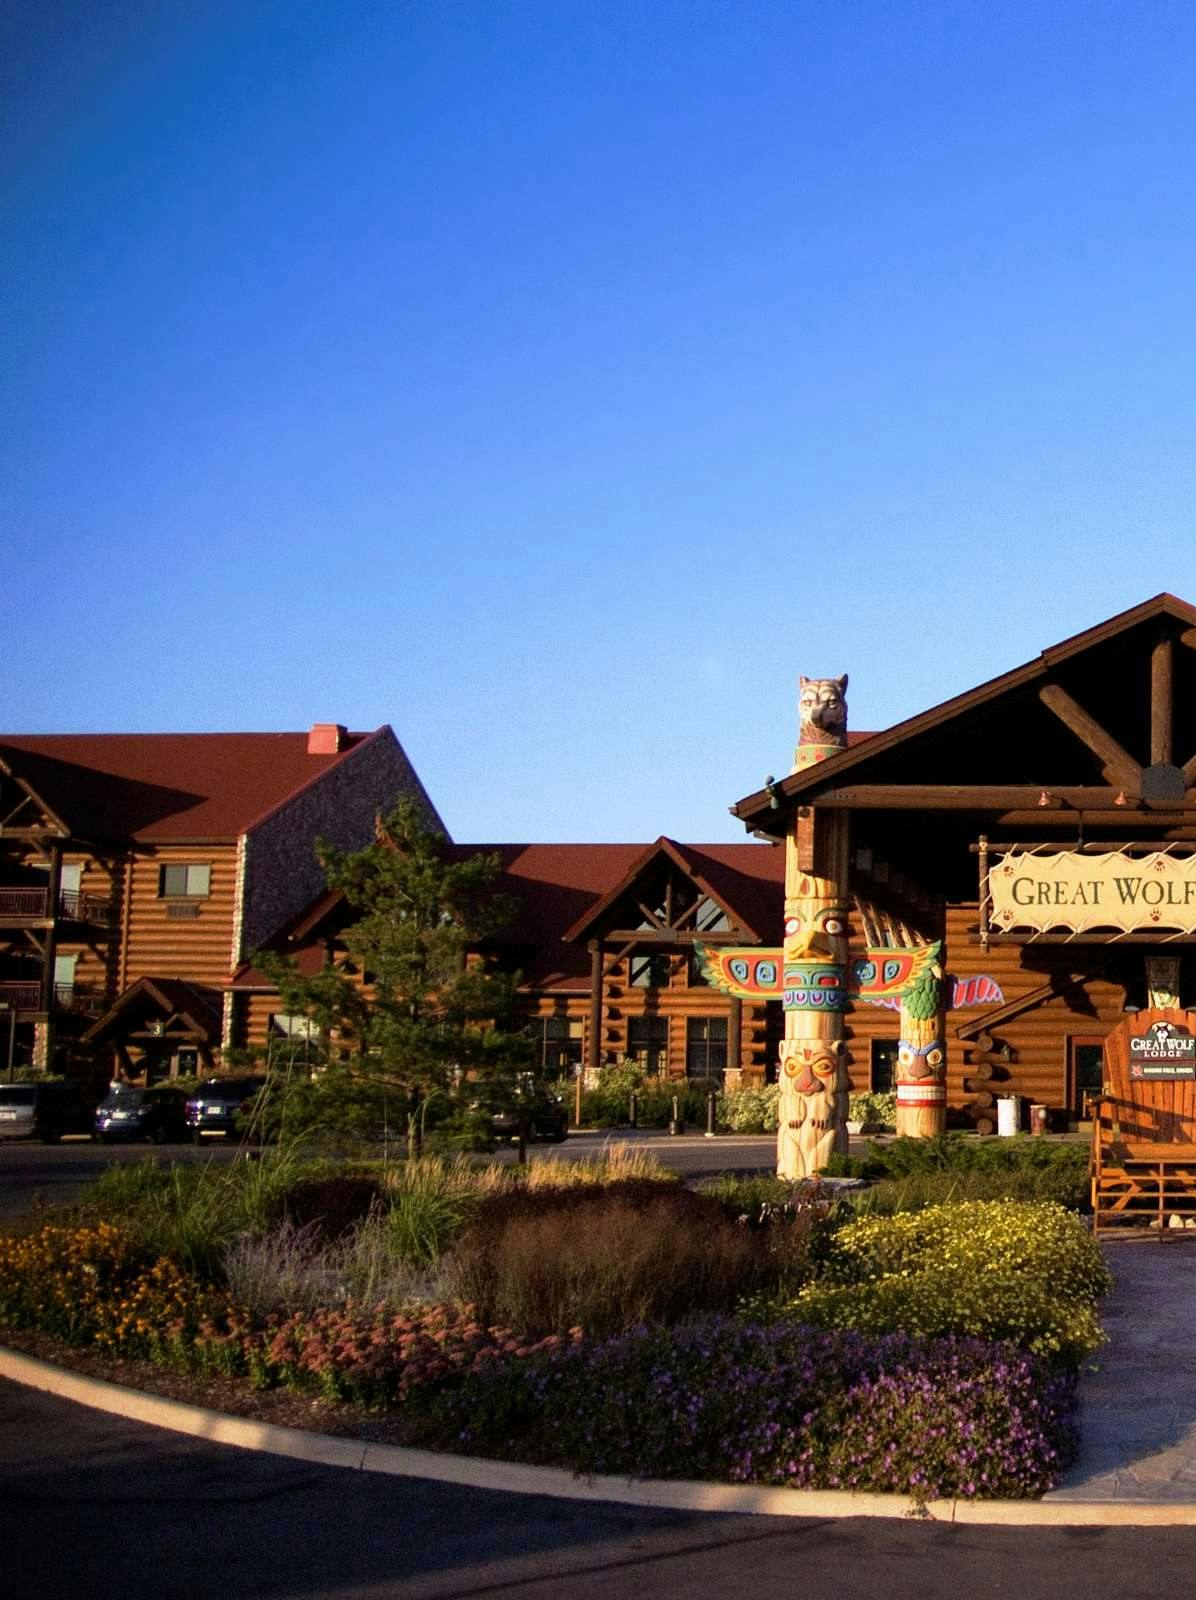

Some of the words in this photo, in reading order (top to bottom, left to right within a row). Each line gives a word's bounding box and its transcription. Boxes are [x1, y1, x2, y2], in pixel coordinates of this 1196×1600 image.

[1011, 877, 1104, 905] GREAT
[153, 1024, 161, 1035] 3
[1130, 1038, 1165, 1051] GREAT
[1167, 1038, 1195, 1051] WOLF
[1144, 1050, 1182, 1058] LODGE
